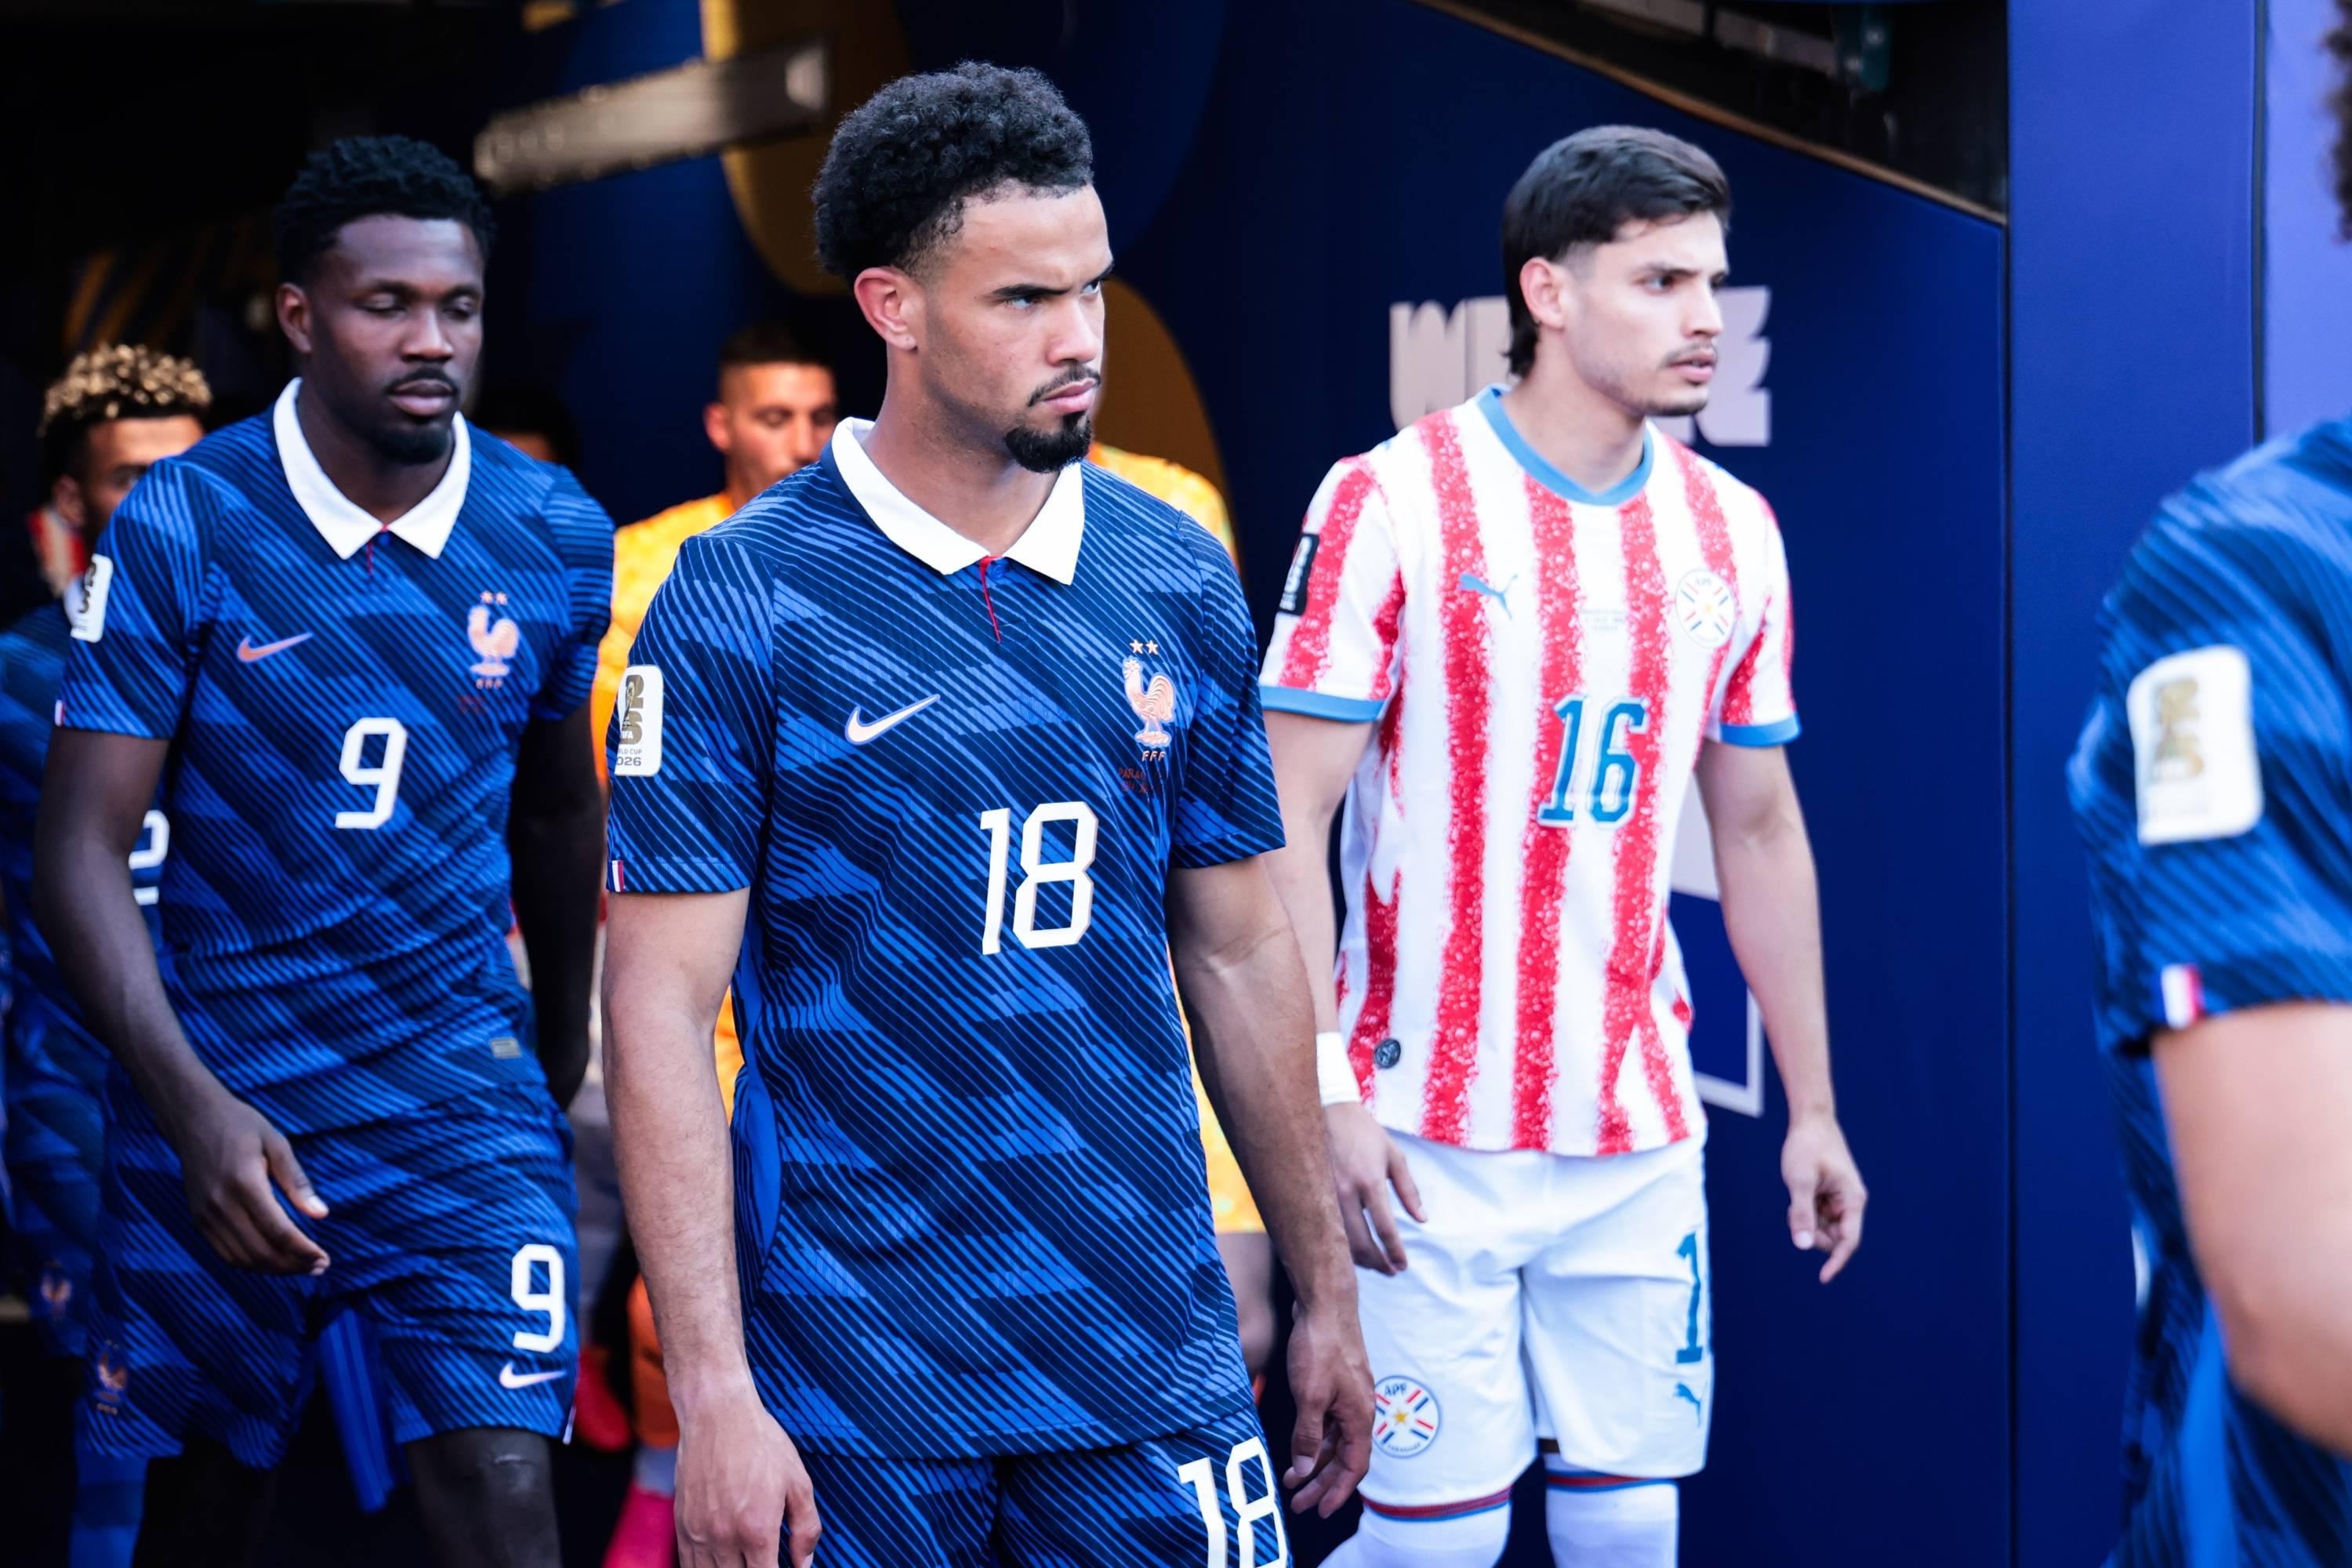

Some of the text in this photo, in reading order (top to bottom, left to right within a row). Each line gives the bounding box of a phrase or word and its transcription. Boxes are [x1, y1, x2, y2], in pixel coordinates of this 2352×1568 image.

[335, 717, 408, 829] 9
[616, 757, 641, 766] 026
[1142, 750, 1166, 762] FFF
[1539, 697, 1648, 826] 16
[980, 801, 1098, 956] 18
[511, 1243, 565, 1353] 9
[1385, 1383, 1406, 1396] APF
[1178, 1436, 1288, 1568] 18
